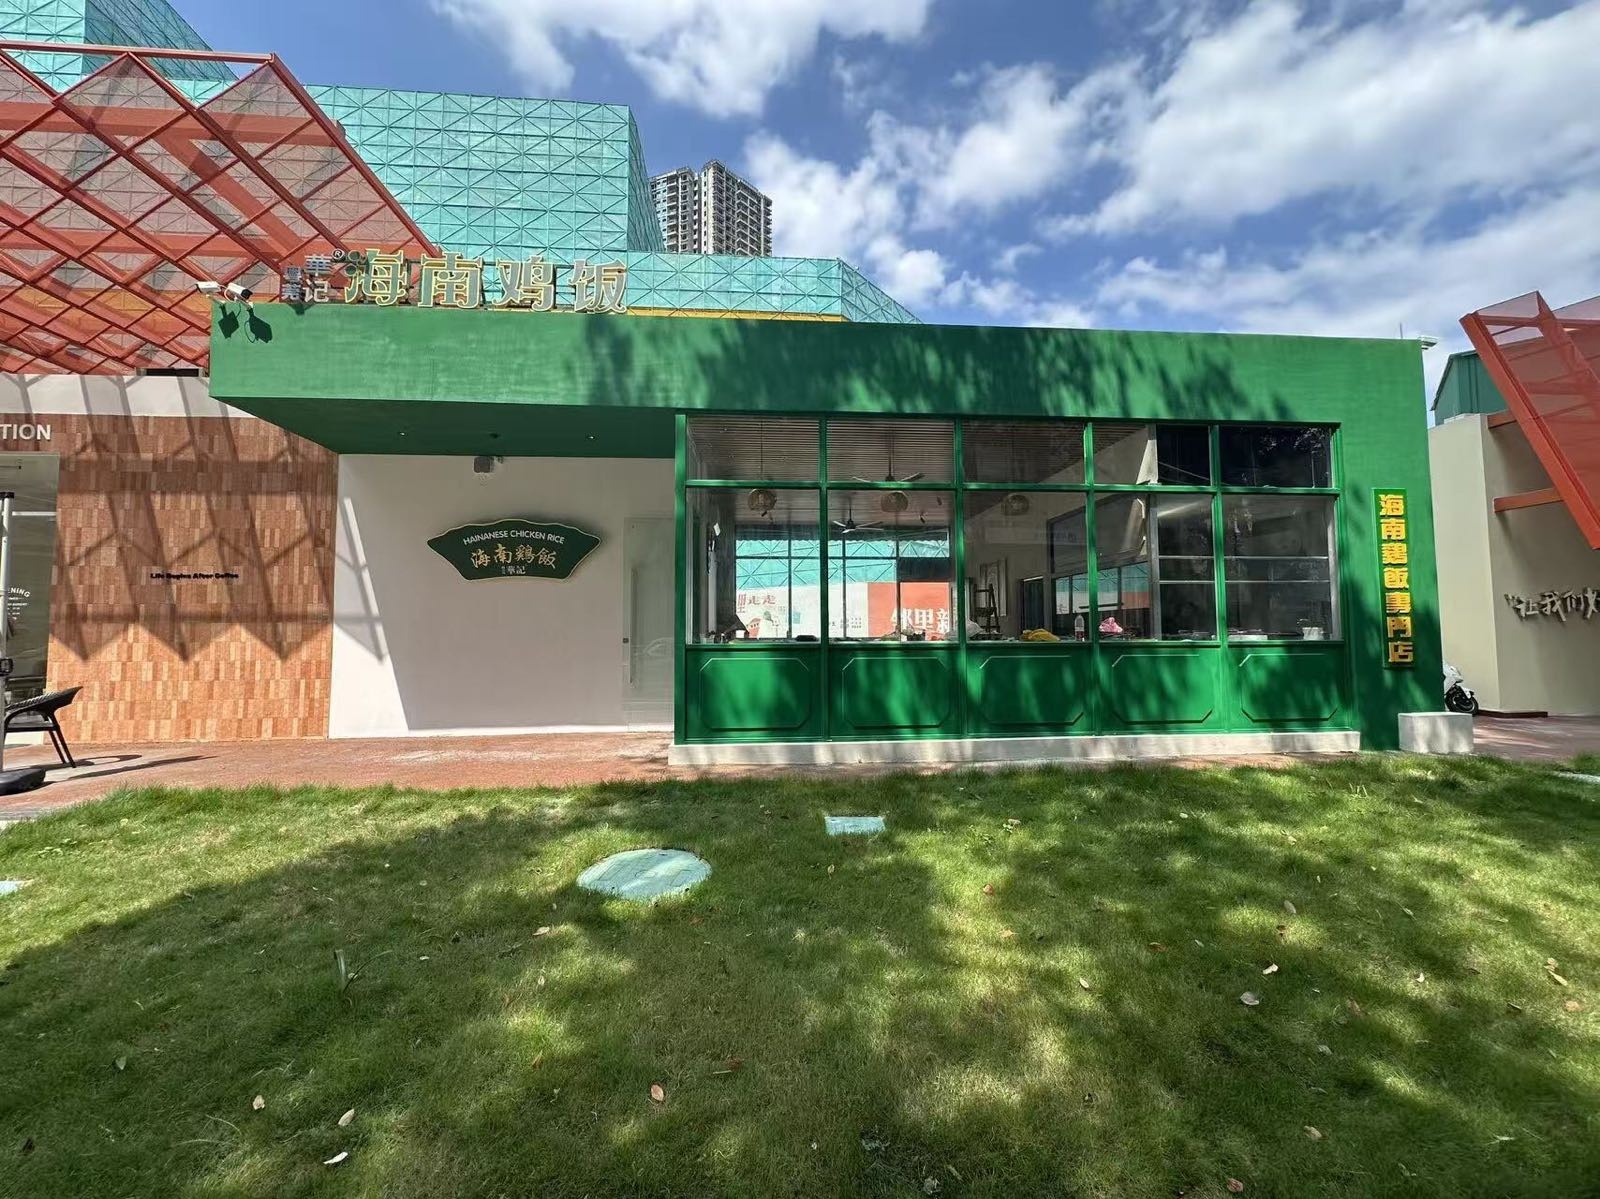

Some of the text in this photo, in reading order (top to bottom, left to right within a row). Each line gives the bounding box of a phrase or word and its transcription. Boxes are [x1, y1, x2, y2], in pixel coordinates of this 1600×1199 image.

[345, 248, 627, 314] 海南鸡饭
[0, 423, 51, 440] TION
[463, 530, 565, 545] HAINANESE CHICKEN RICE
